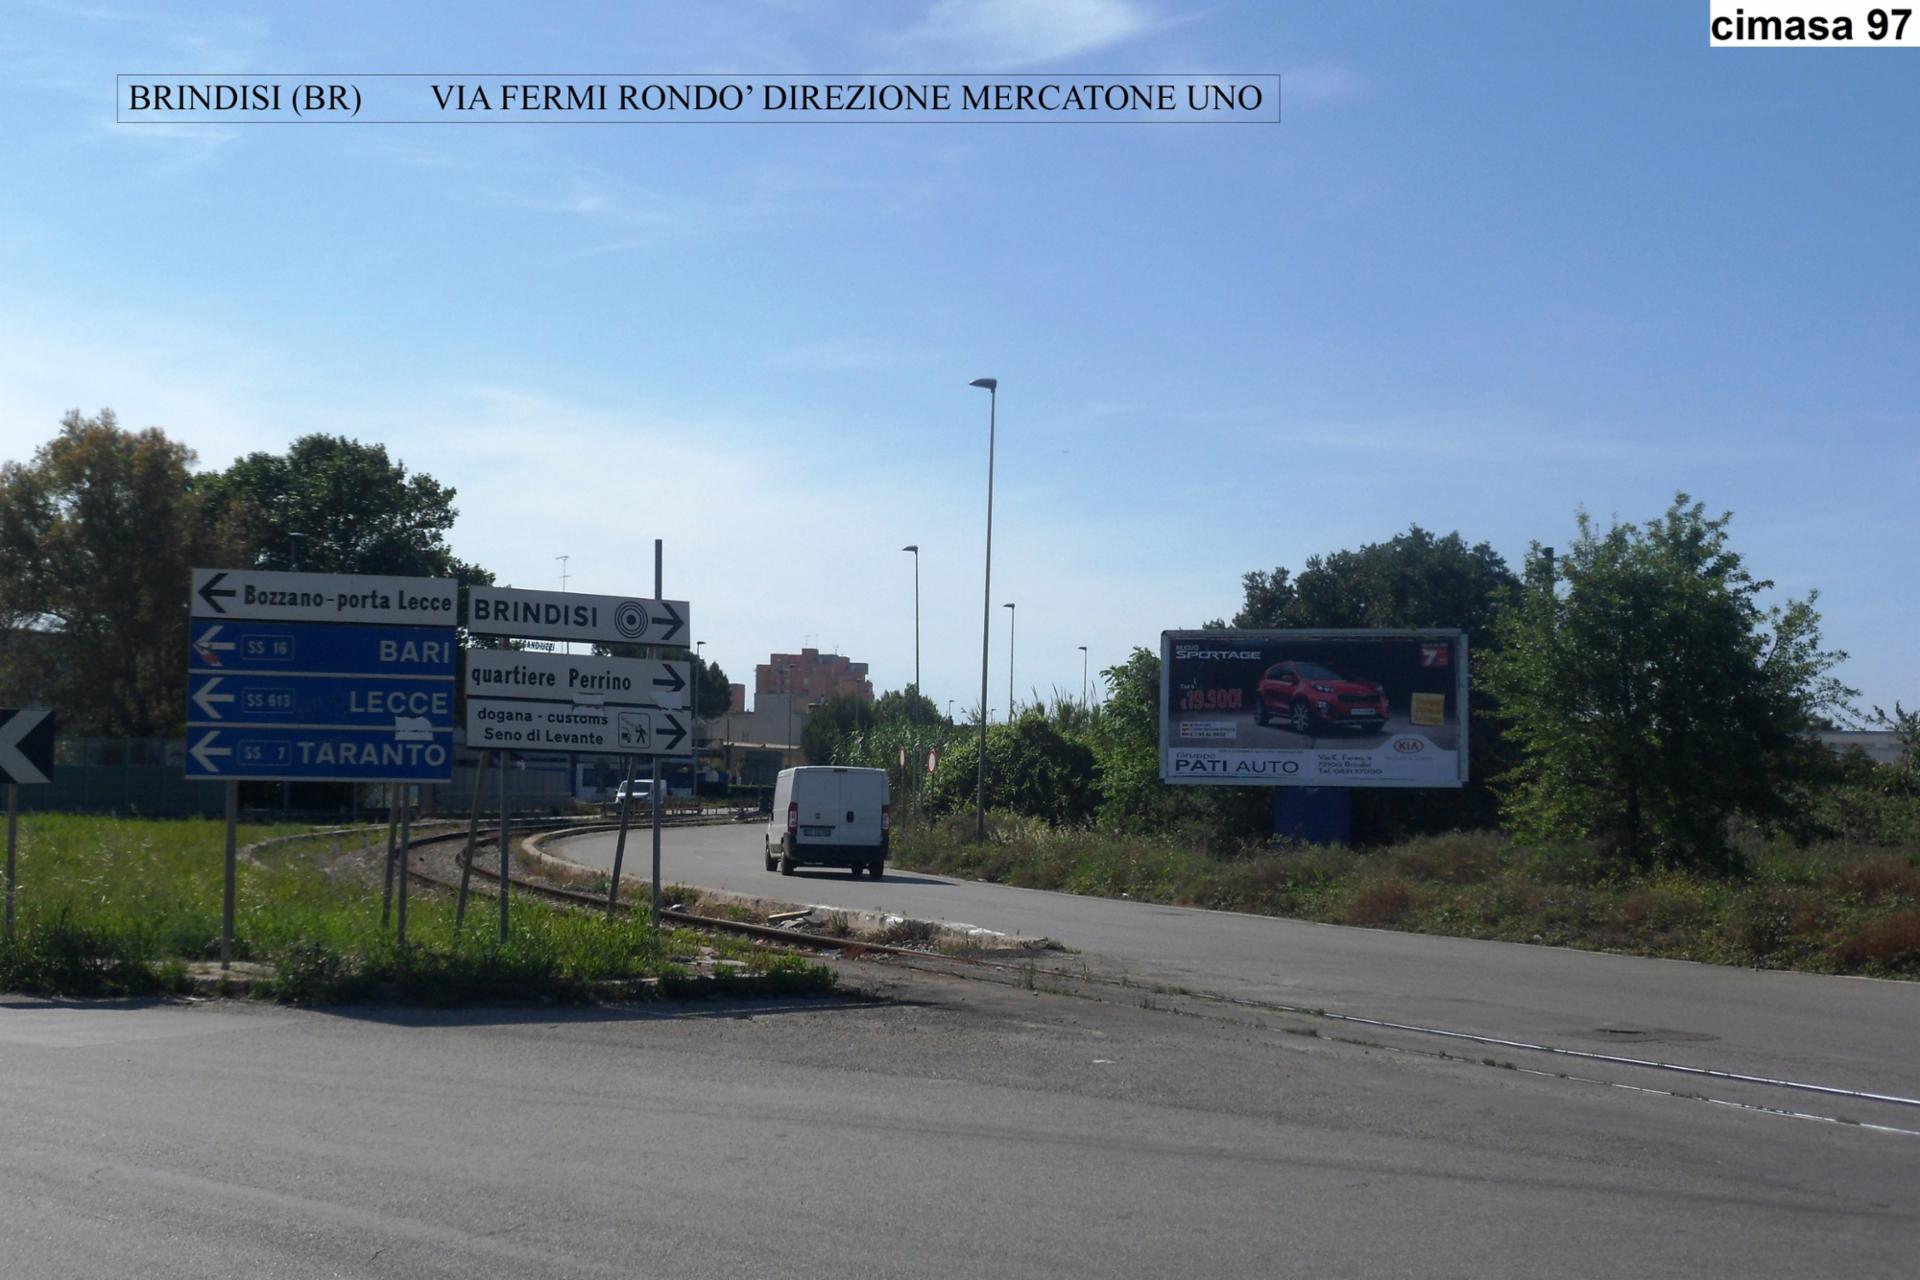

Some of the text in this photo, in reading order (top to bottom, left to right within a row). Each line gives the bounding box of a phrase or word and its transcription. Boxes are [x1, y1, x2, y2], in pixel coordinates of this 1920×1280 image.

[399, 590, 452, 612] Lecce
[475, 598, 598, 628] BRINDISI
[248, 640, 288, 655] SS 16
[379, 639, 449, 664] BARI
[1175, 650, 1262, 660] SPORTAGE
[1421, 648, 1438, 666] 7
[472, 665, 632, 691] quartiere Perrino
[247, 693, 291, 707] SS 613
[350, 690, 449, 715] LECCE
[478, 707, 533, 723] dogana
[547, 713, 609, 725] customs
[484, 727, 604, 745] Seno di Levante
[245, 746, 285, 760] SS 7
[297, 741, 446, 767] TARANTO
[1398, 740, 1420, 751] KIA
[1175, 759, 1299, 774] PATI AUTO
